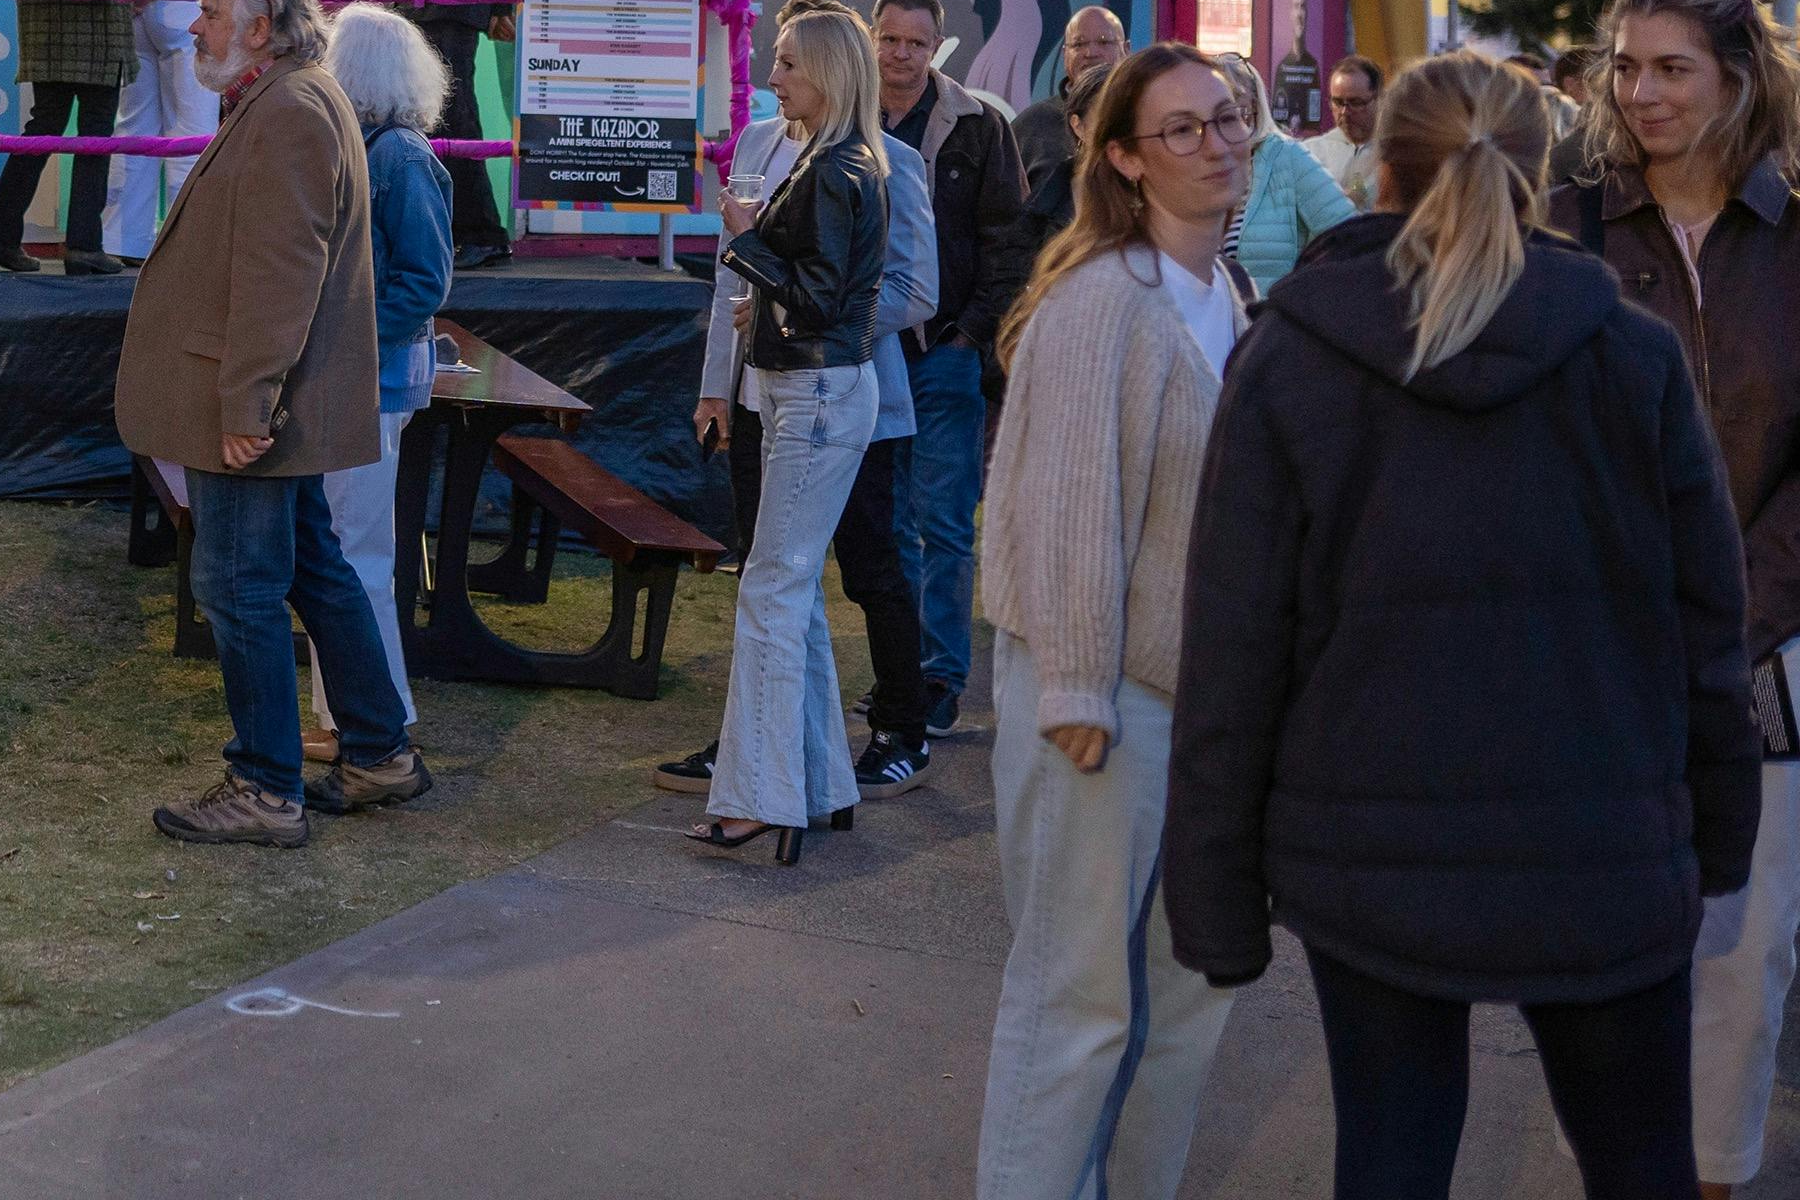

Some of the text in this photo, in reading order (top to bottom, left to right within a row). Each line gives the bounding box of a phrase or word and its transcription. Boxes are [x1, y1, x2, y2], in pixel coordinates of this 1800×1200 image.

[528, 58, 581, 72] SUNDAY
[559, 117, 660, 140] THE KAZADOR
[548, 137, 672, 150] A MINI SPIEGELTENT EXPERIENCE
[549, 170, 620, 183] CHECK IT OUT!
